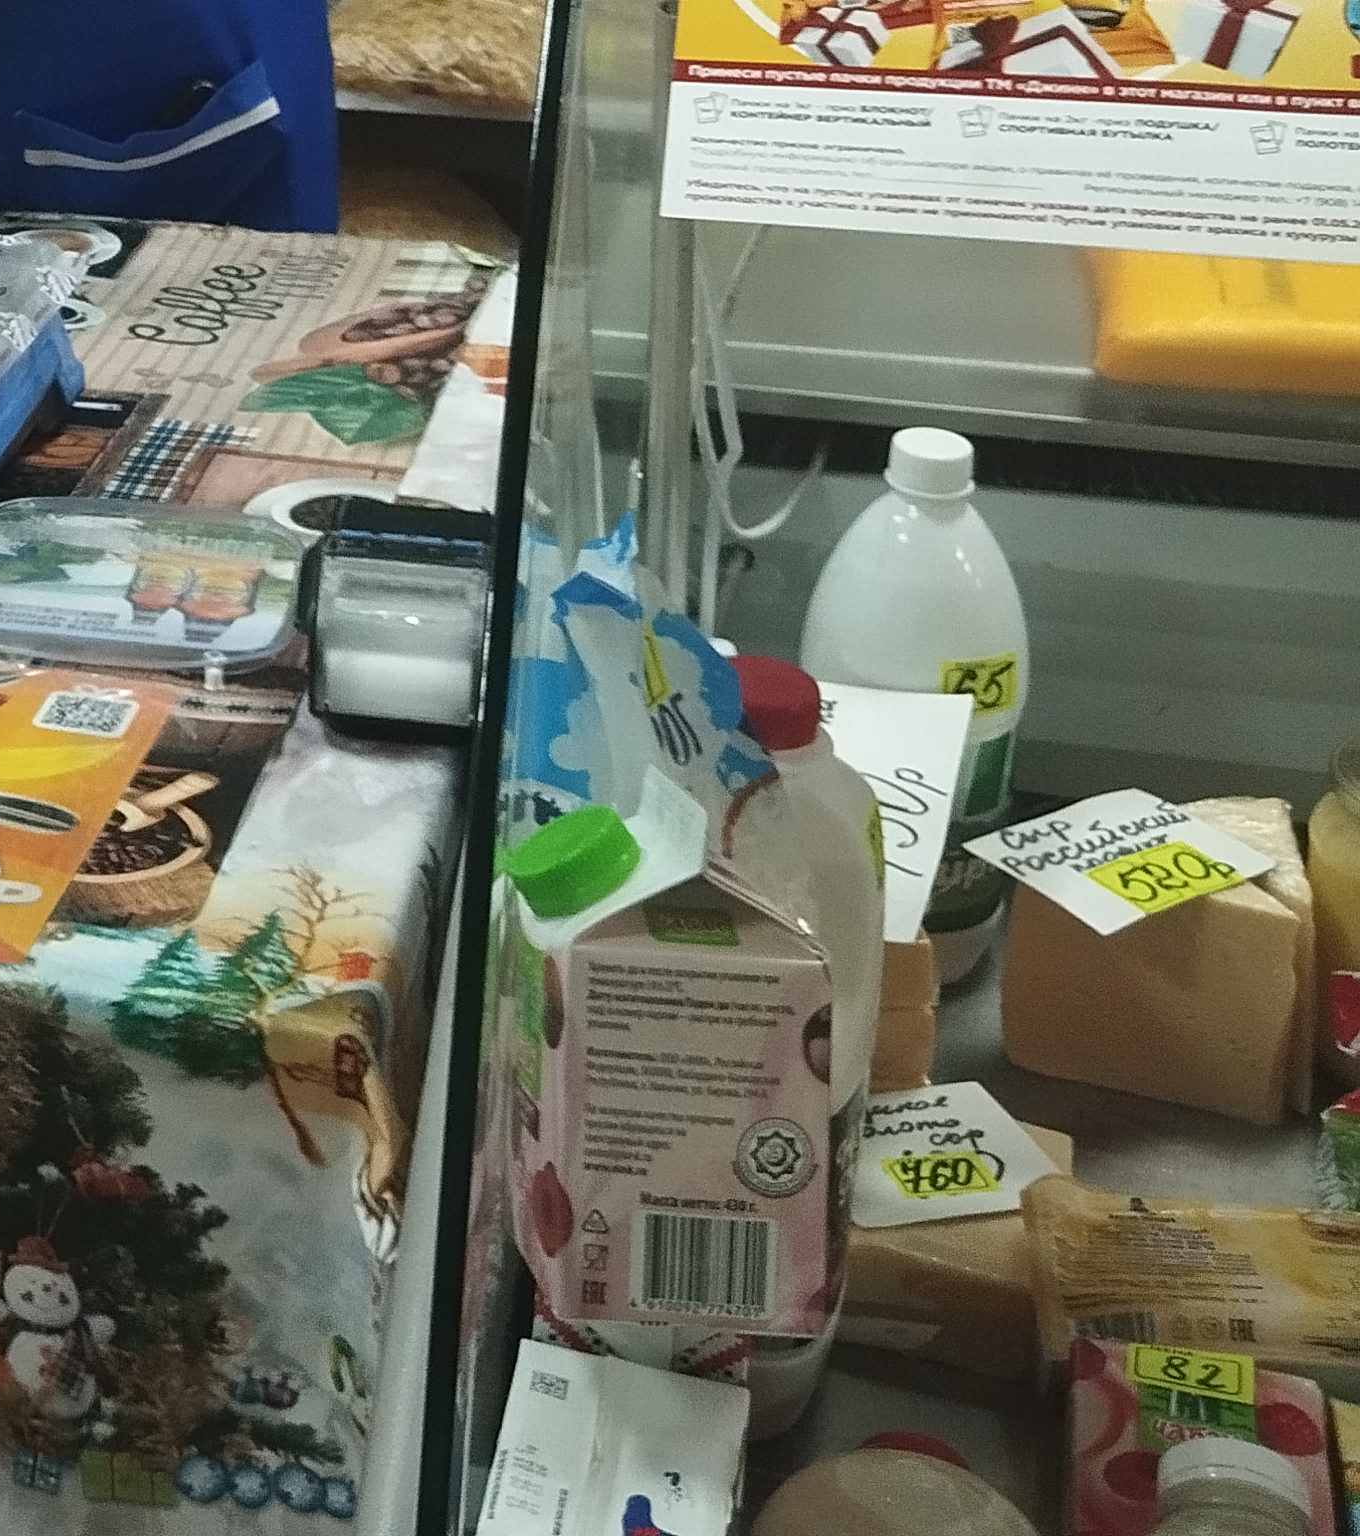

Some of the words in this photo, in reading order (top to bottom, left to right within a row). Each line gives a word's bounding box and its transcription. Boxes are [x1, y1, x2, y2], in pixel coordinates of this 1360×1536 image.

[1159, 89, 1234, 103] магазин
[1117, 851, 1237, 904] 520р
[1161, 1356, 1226, 1392] 82
